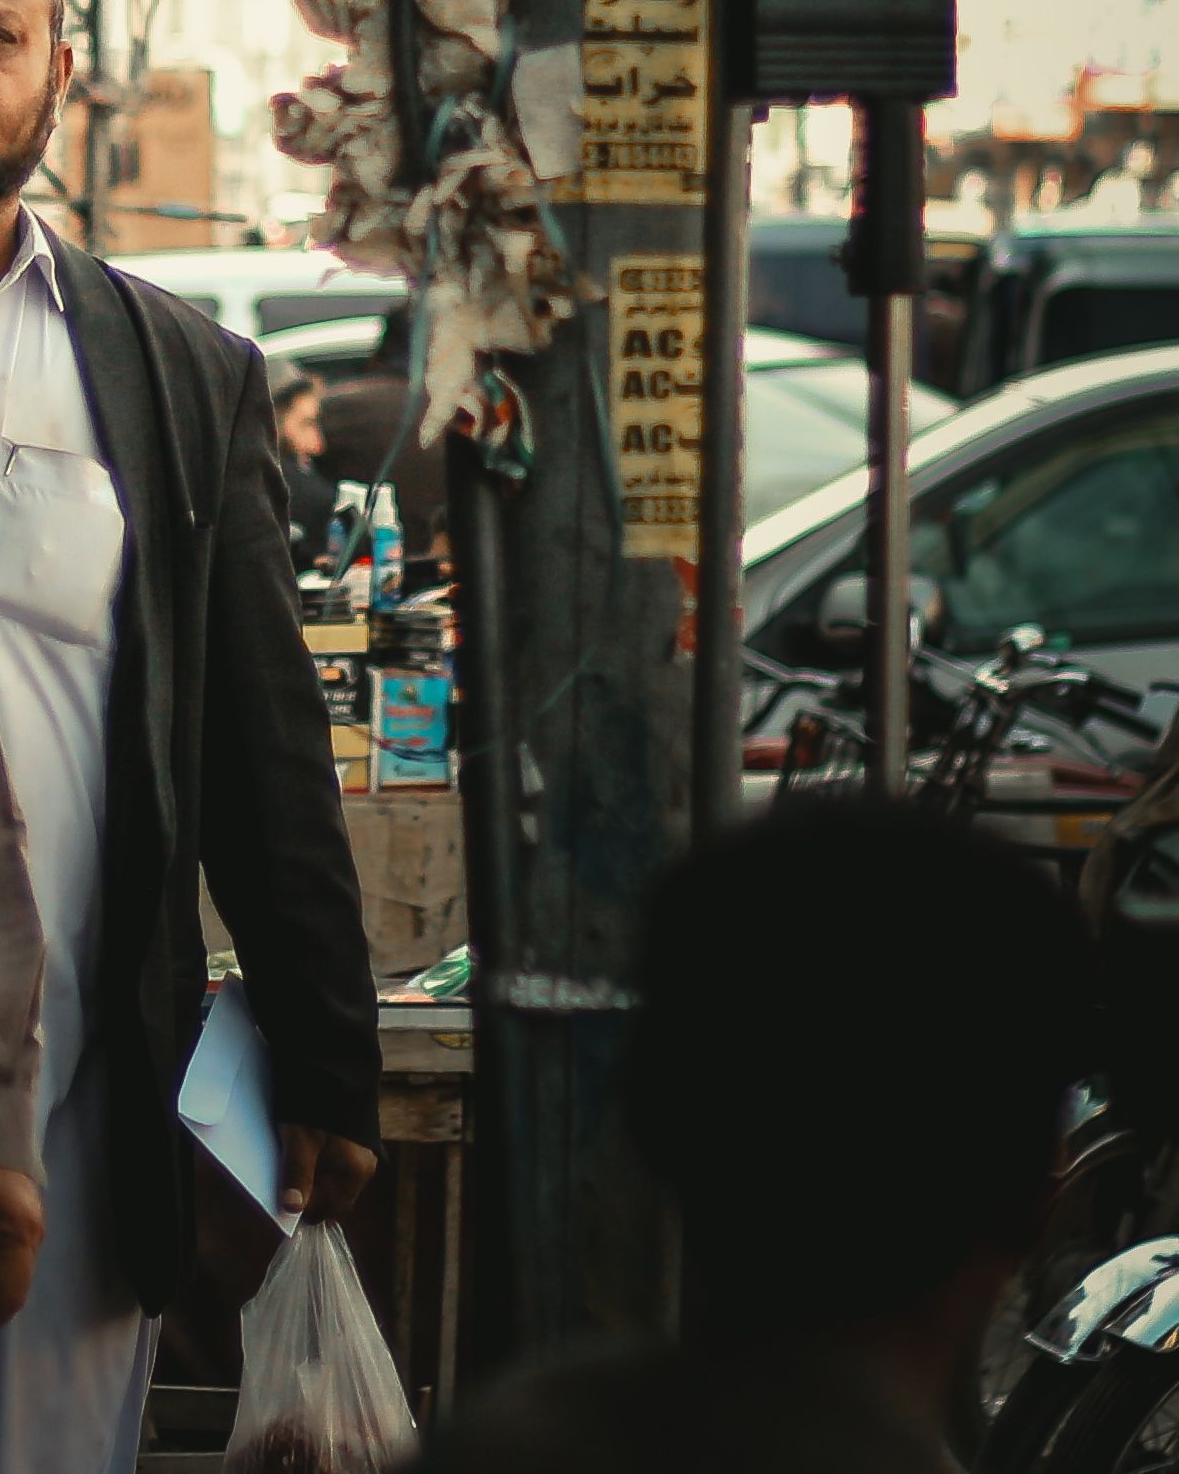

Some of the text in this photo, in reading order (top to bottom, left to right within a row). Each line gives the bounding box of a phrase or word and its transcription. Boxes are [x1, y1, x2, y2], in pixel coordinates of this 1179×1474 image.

[622, 329, 684, 359] AC
[622, 370, 670, 400] AC
[621, 424, 673, 454] AC
